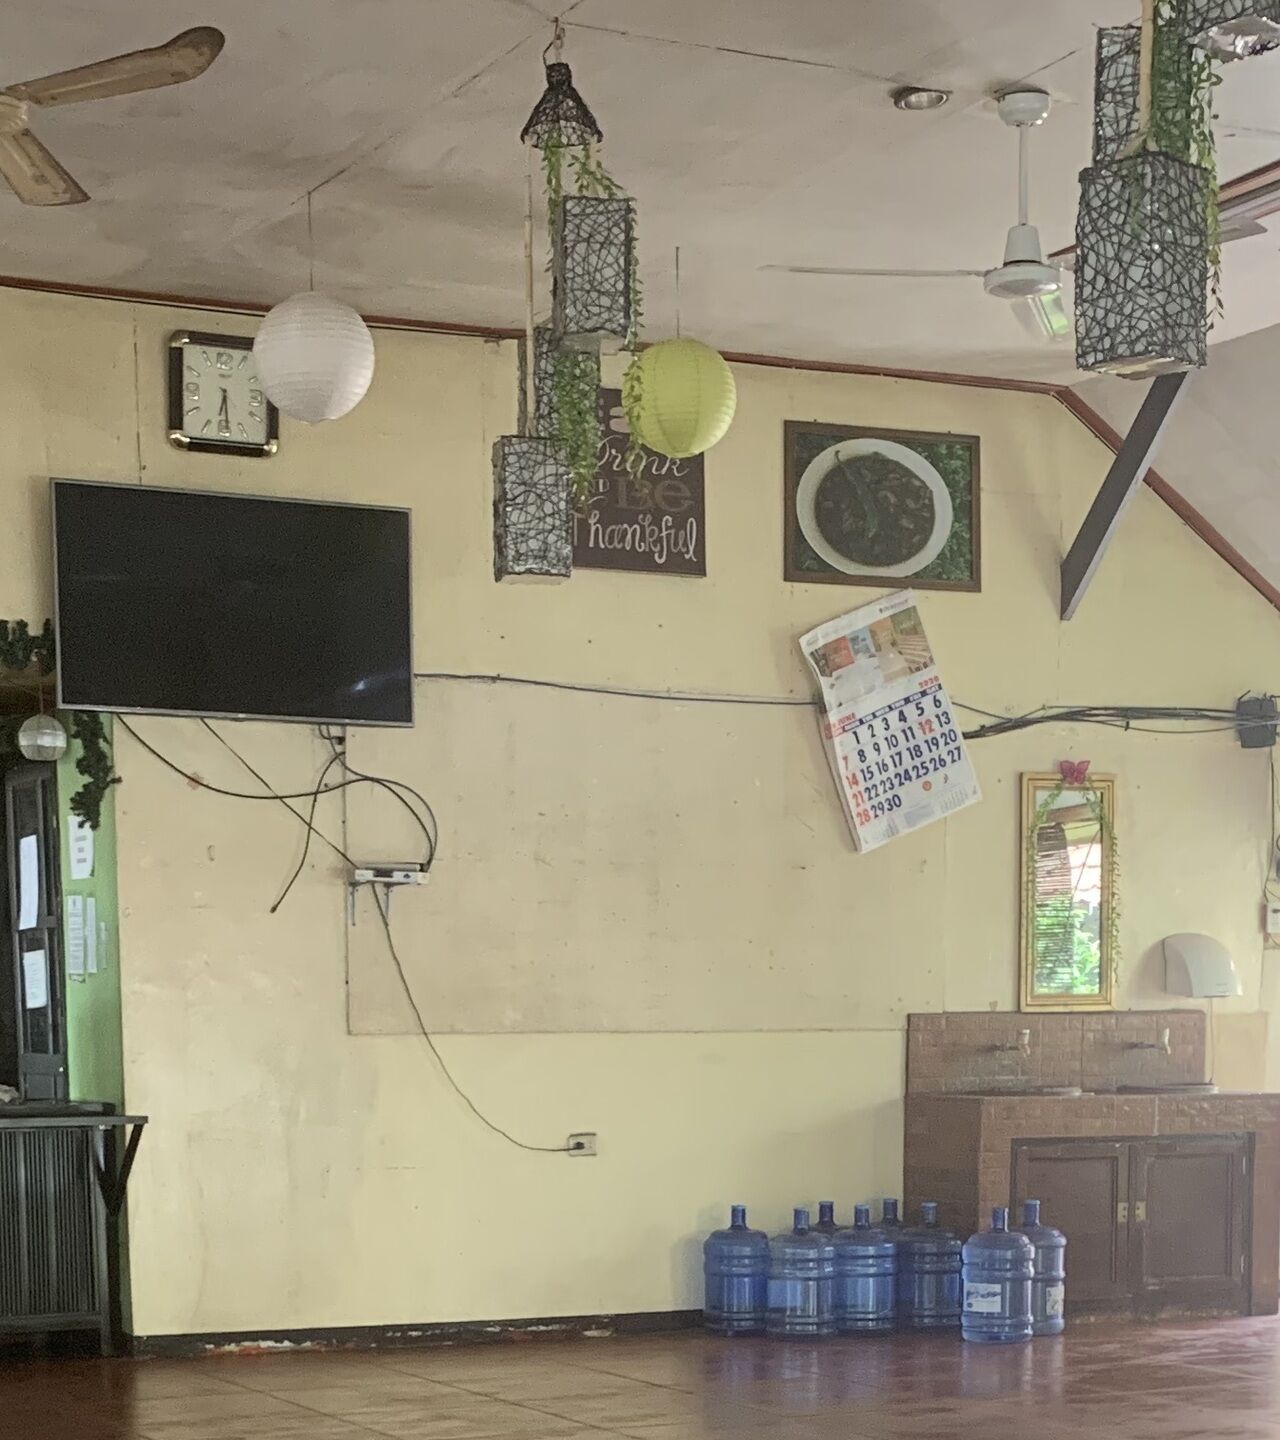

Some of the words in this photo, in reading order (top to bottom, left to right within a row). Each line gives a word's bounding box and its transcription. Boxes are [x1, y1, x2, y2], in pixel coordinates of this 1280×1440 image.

[570, 510, 697, 563] Thankful
[842, 756, 848, 771] 7
[857, 749, 867, 764] 8
[872, 742, 880, 756] 9
[884, 734, 899, 750] 10
[901, 726, 916, 743] 11
[918, 719, 935, 736] 12
[935, 711, 951, 728] 13
[852, 731, 860, 744] 1
[868, 724, 876, 738] 2
[881, 717, 890, 731] 3
[898, 710, 907, 724] 4
[915, 702, 924, 717] 5
[933, 694, 942, 708] 6
[846, 773, 859, 790] 14
[860, 766, 874, 782] 15
[875, 759, 889, 775] 16
[889, 751, 903, 768] 17
[906, 744, 923, 761] 18
[924, 737, 940, 754] 19
[940, 729, 957, 746] 20
[852, 790, 865, 808] 21
[864, 784, 880, 802] 22
[880, 777, 895, 794] 23
[894, 768, 913, 787] 24
[912, 761, 930, 780] 25
[930, 754, 946, 772] 26
[947, 746, 961, 764] 27
[856, 809, 872, 826] 28
[870, 802, 885, 819] 29
[884, 794, 902, 812] 30
